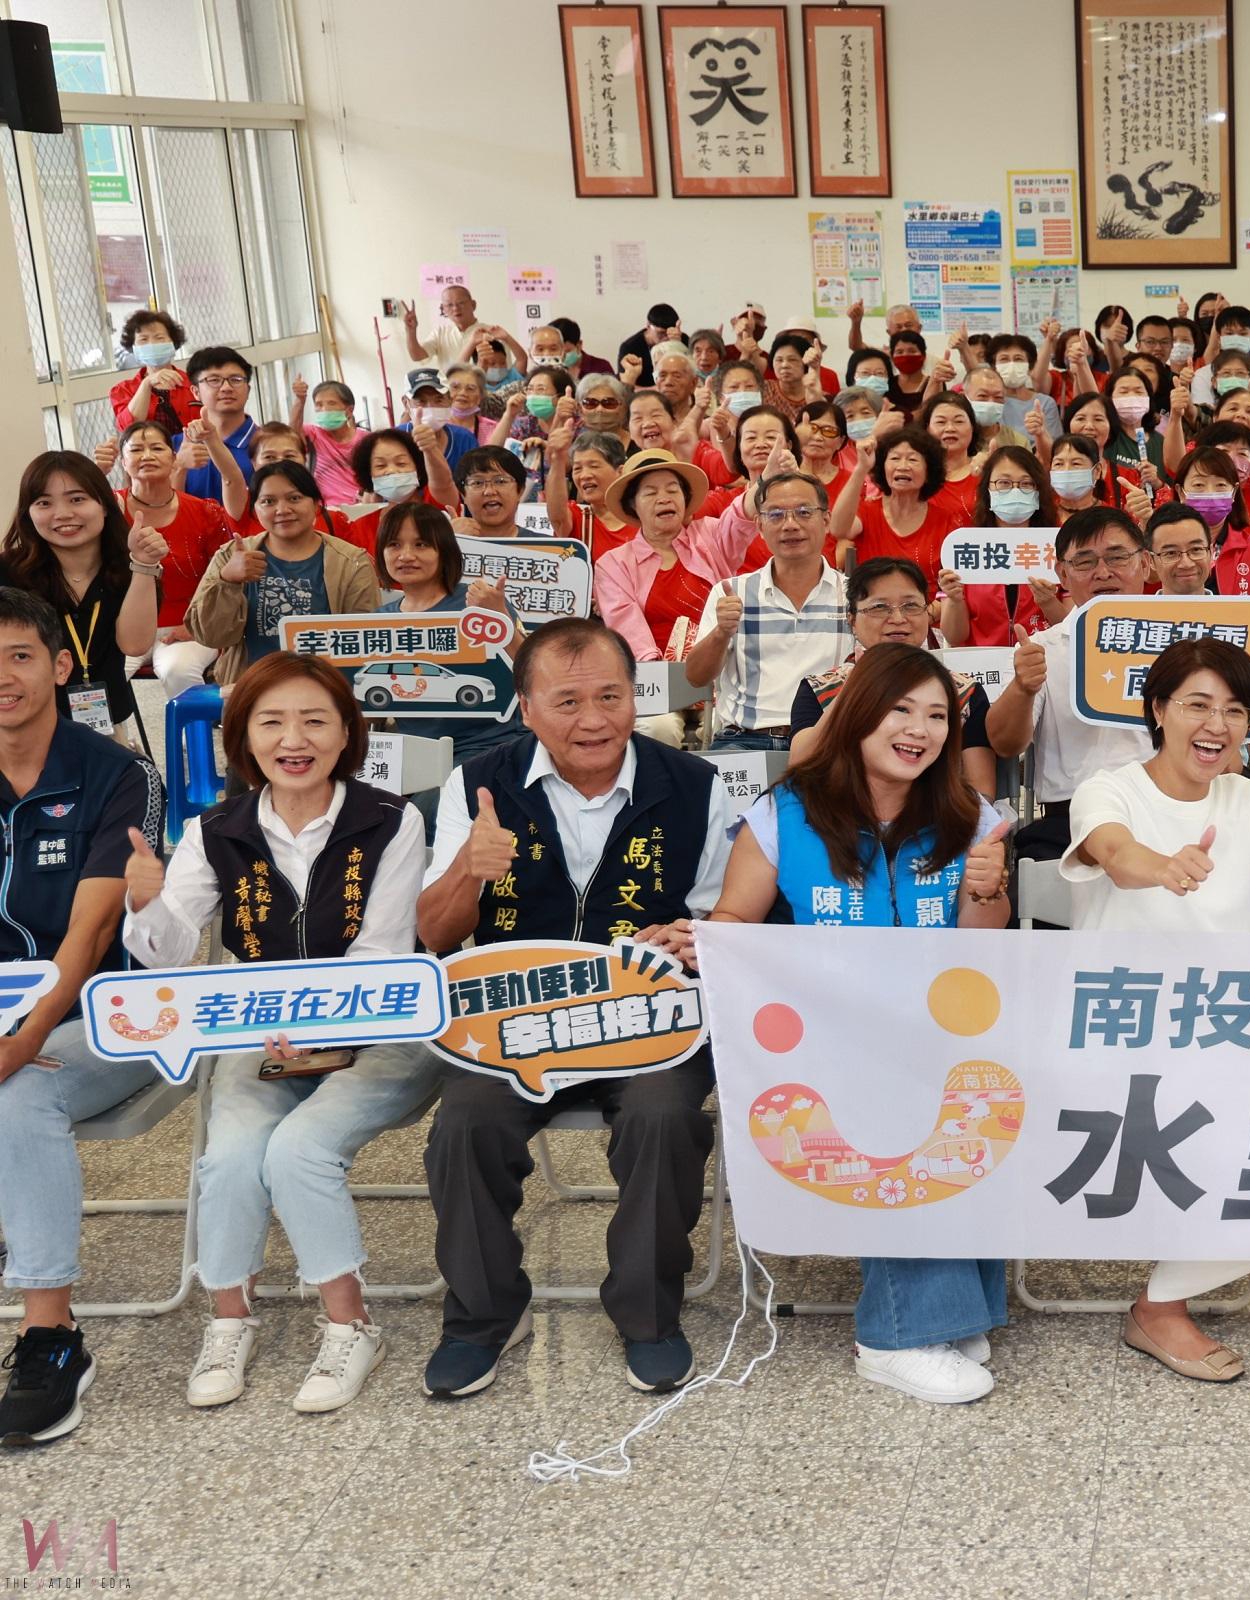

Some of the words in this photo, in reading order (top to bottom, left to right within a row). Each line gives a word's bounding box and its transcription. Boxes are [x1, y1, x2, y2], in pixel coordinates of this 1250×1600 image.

[907, 211, 980, 221] 水里鄉幸福巴士
[467, 617, 503, 640] GO
[297, 626, 458, 656] 幸福開車囉
[634, 683, 661, 697] 國小
[722, 769, 748, 784] 客運
[38, 838, 66, 852] 臺中區
[37, 852, 67, 866] 監理所
[651, 826, 665, 893] 立法委員
[341, 846, 364, 940] 南投縣政府
[448, 956, 610, 1019] 行動便利
[192, 981, 421, 1029] 幸福在水里
[500, 985, 702, 1060] 幸福接力
[961, 1073, 1002, 1089] 南投
